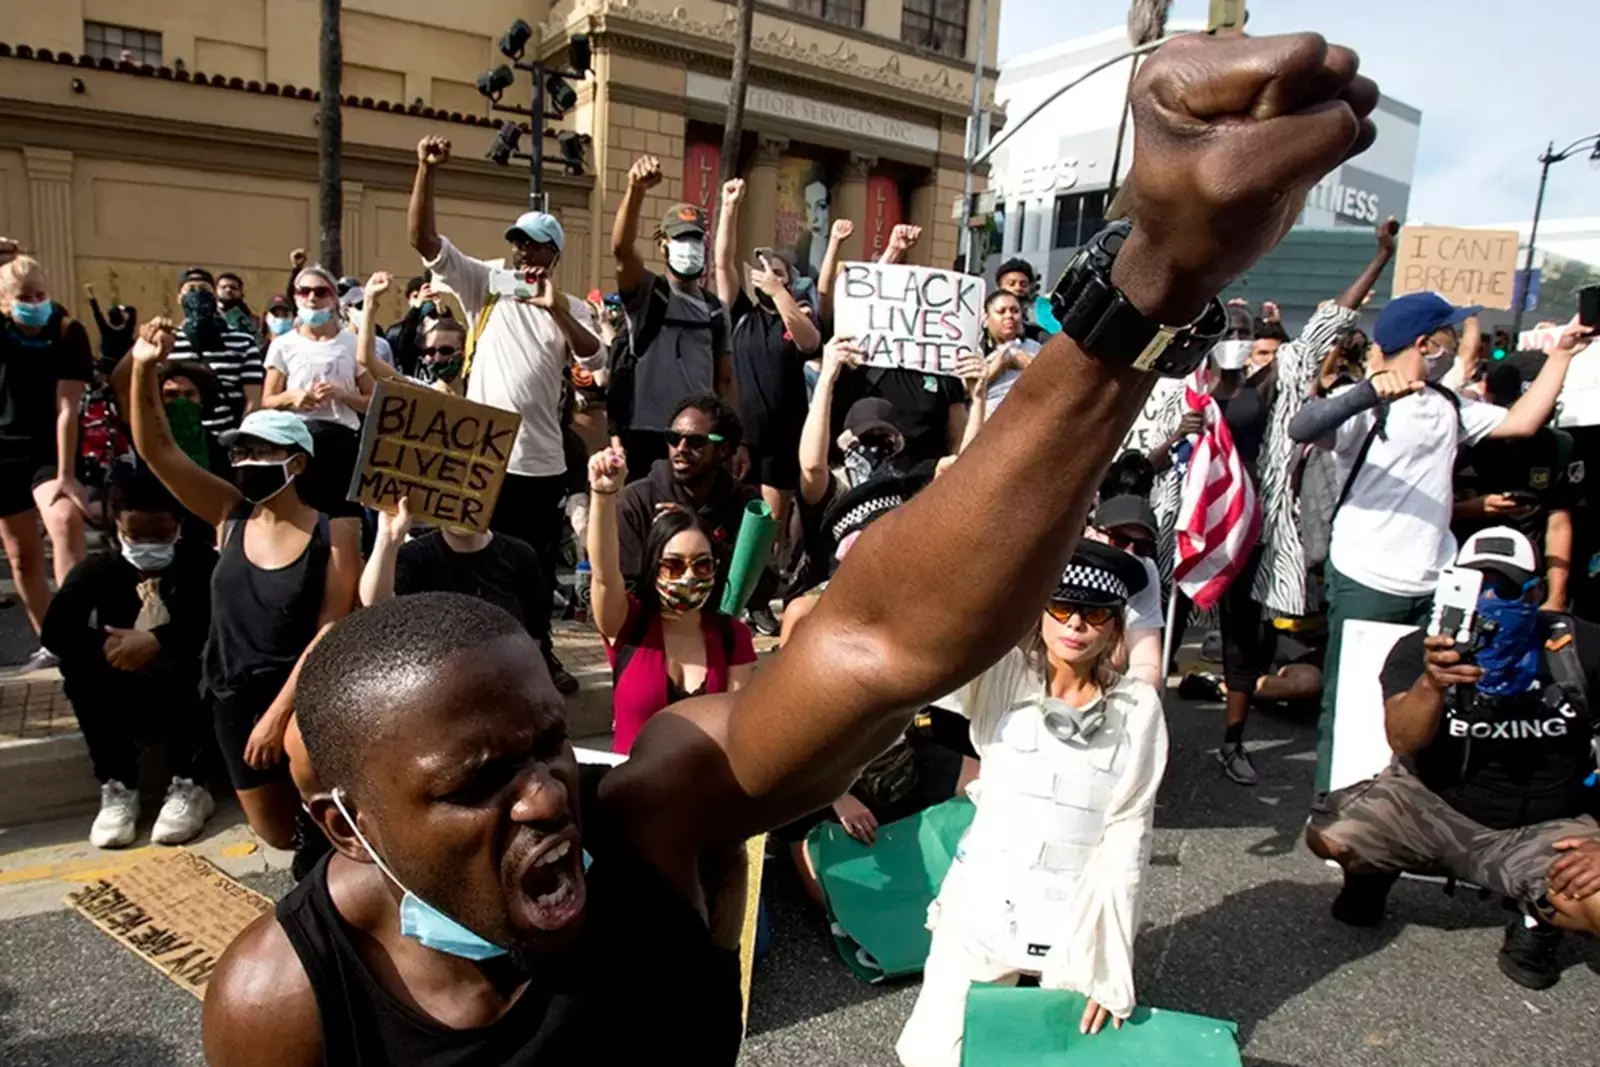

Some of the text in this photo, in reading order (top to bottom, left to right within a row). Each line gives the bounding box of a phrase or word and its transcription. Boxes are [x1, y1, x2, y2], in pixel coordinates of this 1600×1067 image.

[1410, 235, 1511, 262] I CANT
[845, 266, 975, 316] BLACK
[1403, 264, 1507, 295] BREATHE
[868, 304, 962, 341] LIVES
[377, 396, 513, 461] BLACK
[369, 438, 495, 492] LIVES
[356, 470, 484, 527] MATTER
[1449, 717, 1568, 739] BOXING
